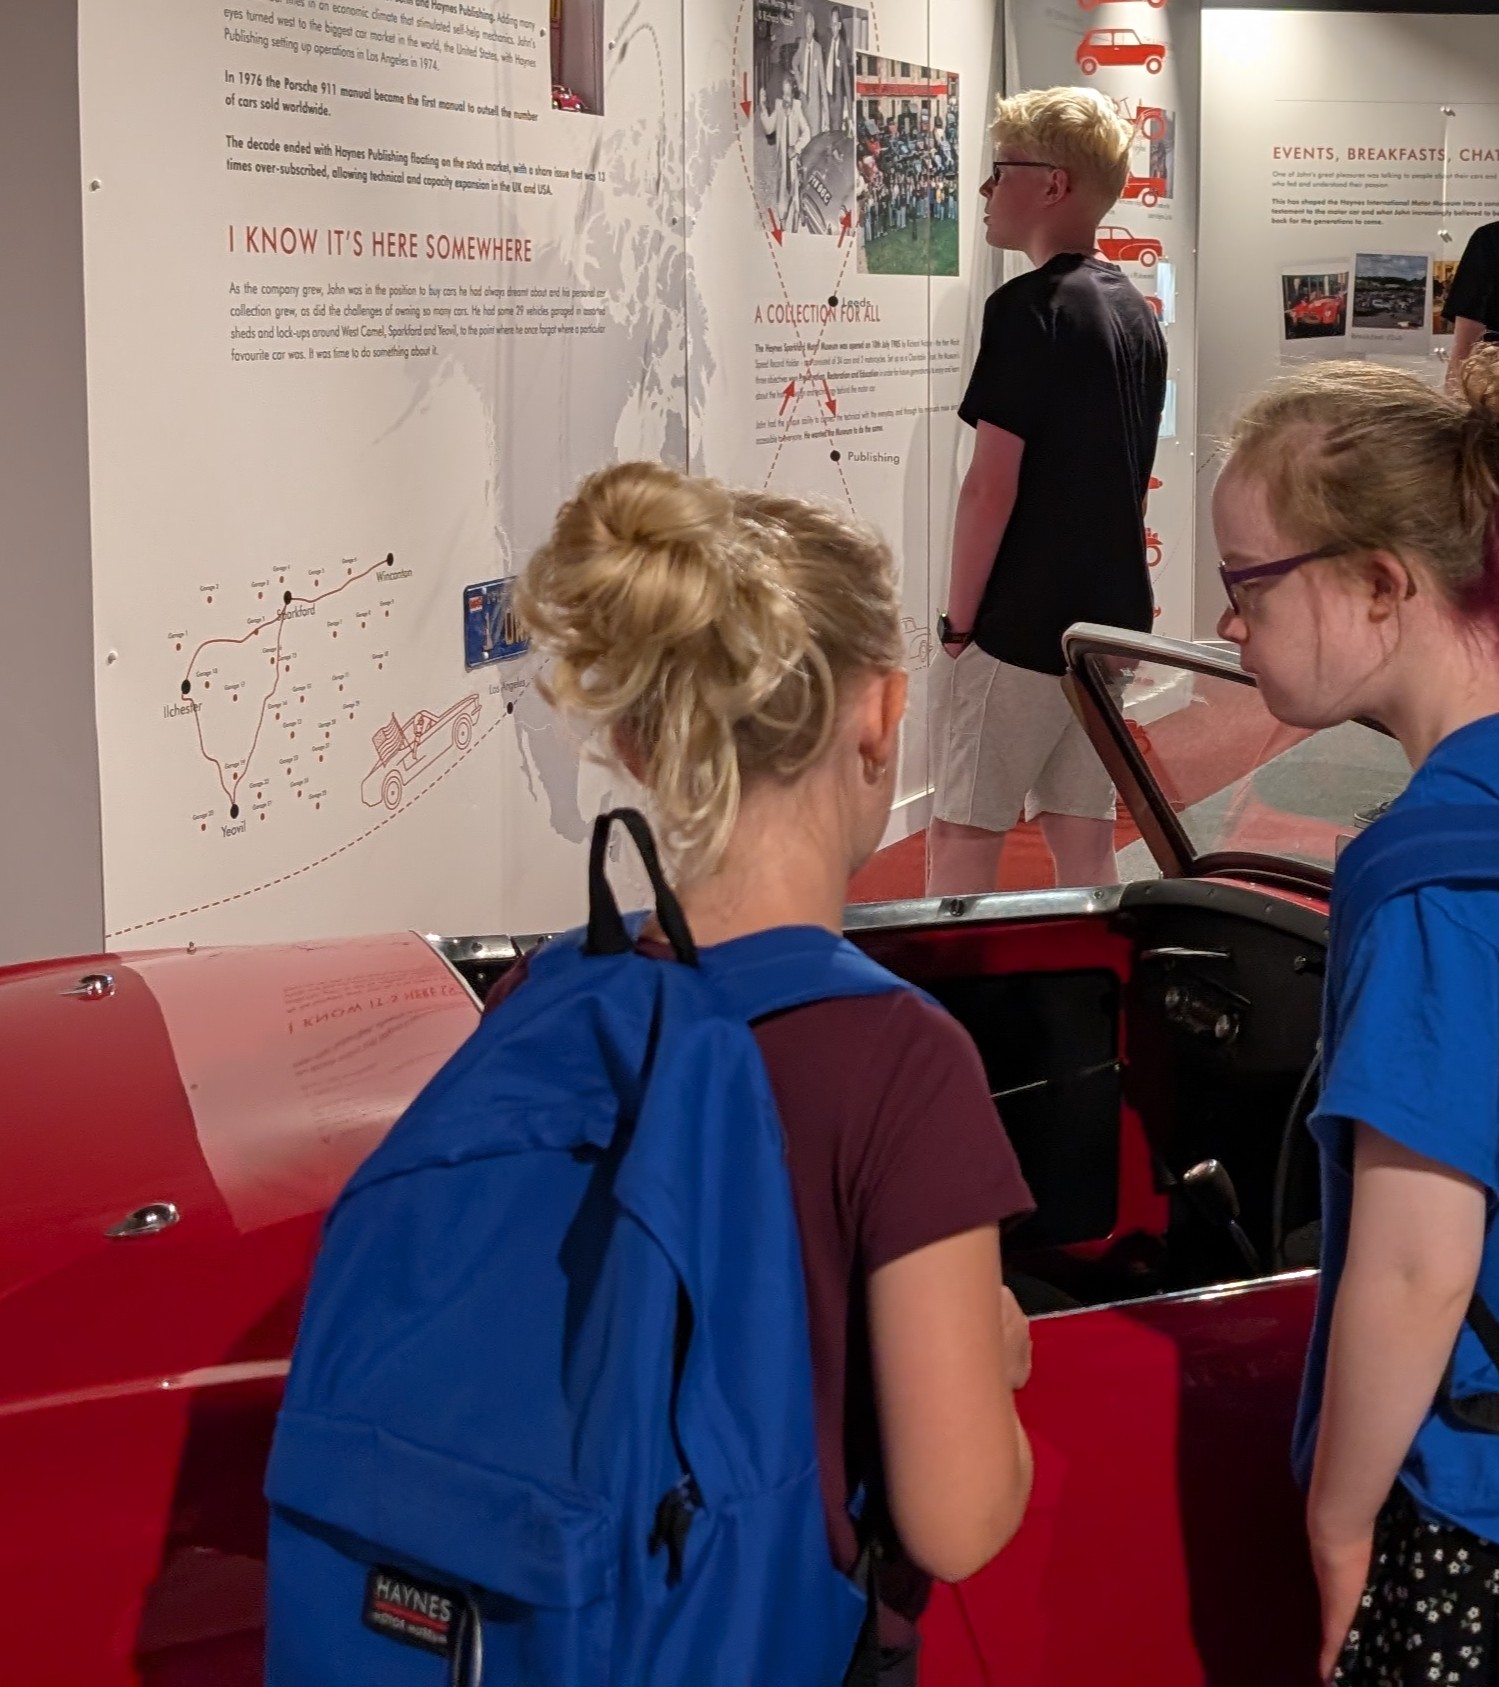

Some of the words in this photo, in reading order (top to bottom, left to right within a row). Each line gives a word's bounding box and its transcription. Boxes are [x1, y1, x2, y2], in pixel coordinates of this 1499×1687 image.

[225, 28, 269, 48] Publishing
[272, 37, 298, 52] setting
[301, 43, 311, 55] up
[314, 45, 355, 58] operations
[357, 47, 364, 59] in
[367, 49, 378, 62] Los
[380, 52, 408, 67] Angeles
[411, 56, 417, 67] in
[420, 58, 439, 71] 1974.
[225, 70, 234, 83] In
[239, 72, 262, 86] 1976
[266, 75, 280, 89] the
[285, 78, 317, 93] Porsche
[321, 82, 336, 95] 911
[340, 87, 371, 99] manual
[374, 89, 404, 104] became
[407, 94, 419, 106] the
[422, 95, 435, 108] first
[439, 100, 465, 112] manual
[468, 103, 474, 113] to
[477, 104, 498, 116] outsell
[501, 106, 511, 117] the
[514, 110, 537, 121] number
[225, 94, 235, 105] of
[238, 97, 257, 108] cars
[261, 98, 279, 110] sold
[283, 101, 331, 116] worldwide.
[226, 135, 243, 148] The
[247, 137, 280, 151] decade
[284, 141, 310, 154] ended
[314, 144, 332, 156] with
[335, 145, 365, 161] Haynes
[368, 148, 408, 166] Publishing
[411, 152, 439, 168] floating
[441, 158, 451, 167] on
[453, 157, 464, 168] the
[467, 159, 483, 170] stock
[486, 162, 511, 174] market,
[1273, 147, 1339, 162] EVENTS,
[1347, 148, 1451, 163] BREAKFASTS,
[227, 159, 252, 172] times
[256, 162, 329, 179] over-subscribed,
[332, 167, 367, 183] allowing
[370, 171, 404, 183] technical
[407, 173, 421, 184] and
[423, 176, 453, 189] capacity
[230, 225, 233, 252] I
[247, 226, 317, 254] KNOW
[372, 232, 417, 258] HERE
[427, 233, 531, 262] SOMEWHERE
[230, 282, 240, 294] As
[244, 282, 257, 294] the
[262, 285, 299, 297] company
[303, 285, 323, 297] grew,
[327, 283, 345, 294] John
[842, 298, 871, 308] Leeds
[755, 305, 763, 323] A
[767, 304, 835, 323] COLLECTION
[841, 305, 861, 322] FOR
[864, 305, 880, 322] ALL
[848, 451, 900, 464] Publishing
[376, 568, 412, 582] Wincanton
[489, 684, 499, 695] Los
[501, 678, 526, 692] Angeles
[164, 703, 202, 719] Ilchester
[221, 821, 246, 837] Yeovil
[376, 1575, 451, 1622] HAYNES
